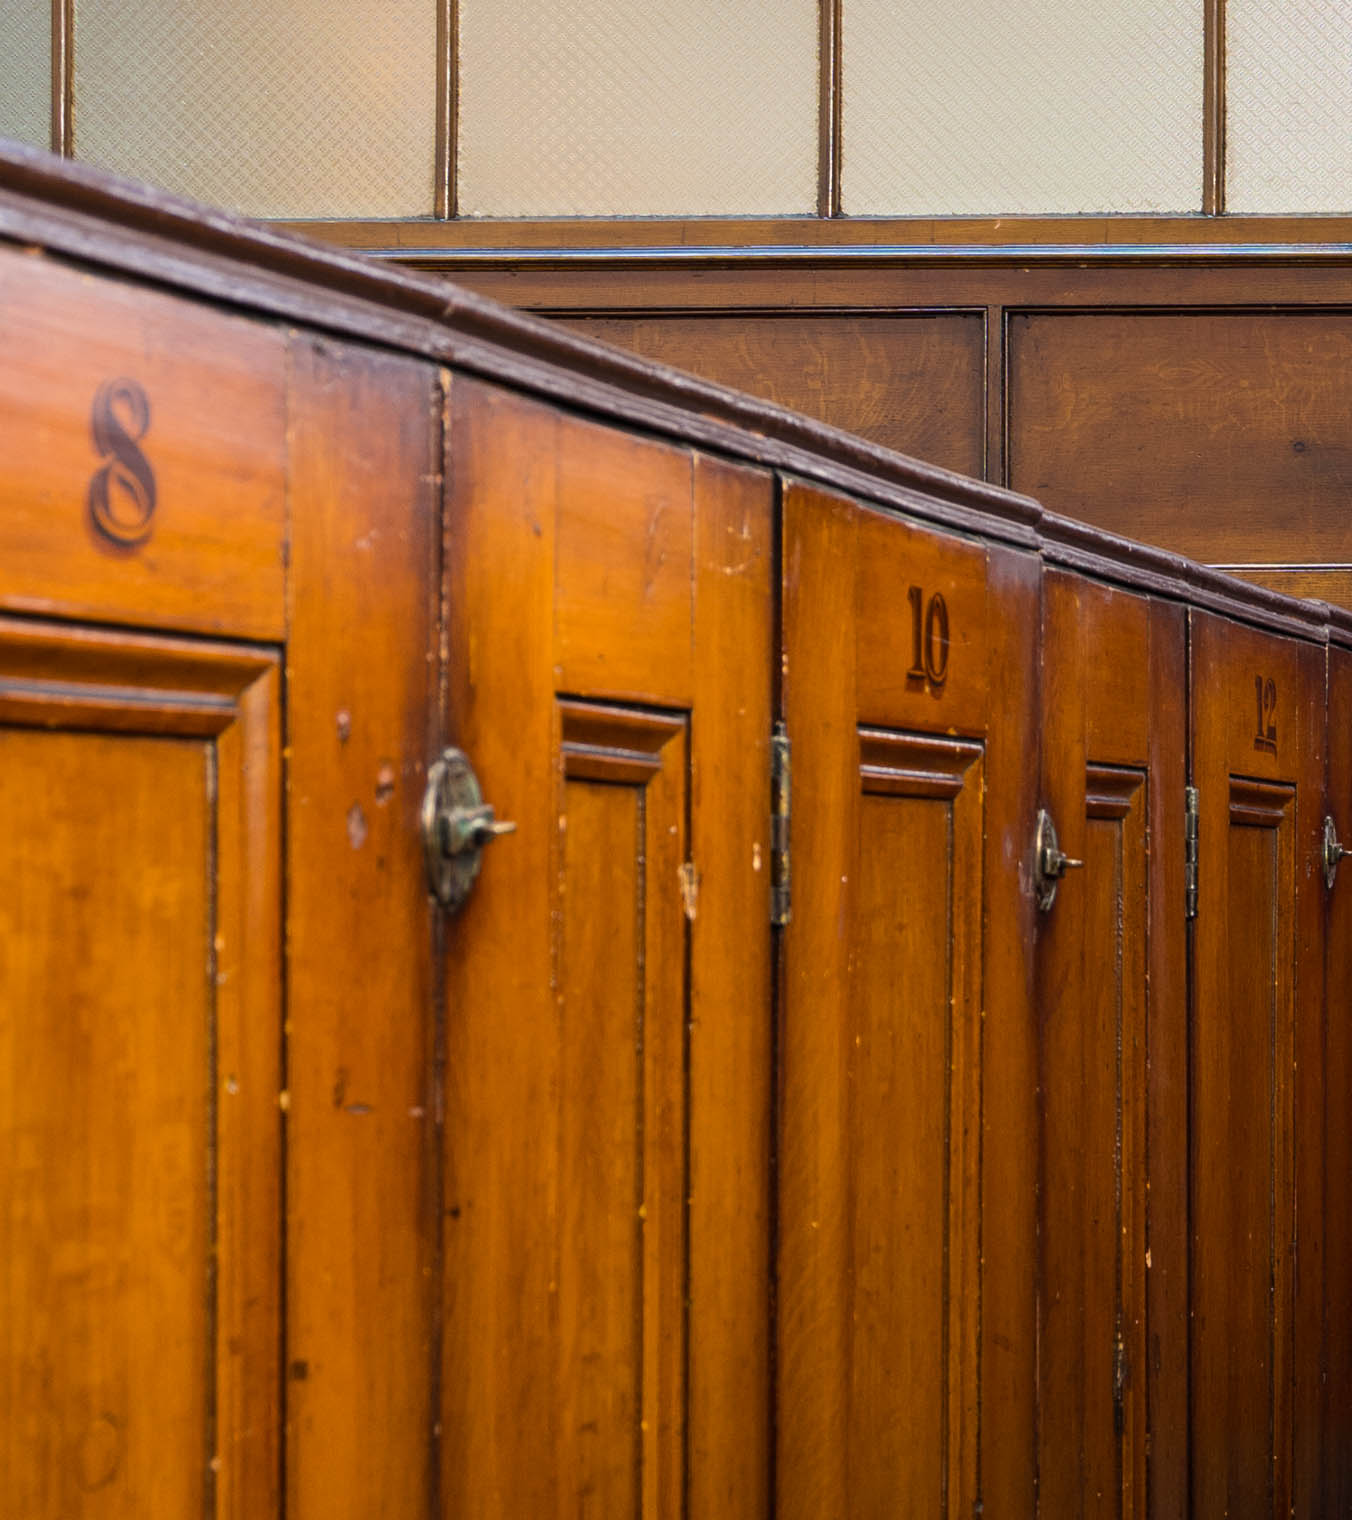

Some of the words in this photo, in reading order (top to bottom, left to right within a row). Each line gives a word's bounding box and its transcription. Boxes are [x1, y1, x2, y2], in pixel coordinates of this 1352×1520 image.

[89, 377, 157, 557] 8
[905, 585, 950, 700] 10
[1253, 674, 1278, 761] 12
